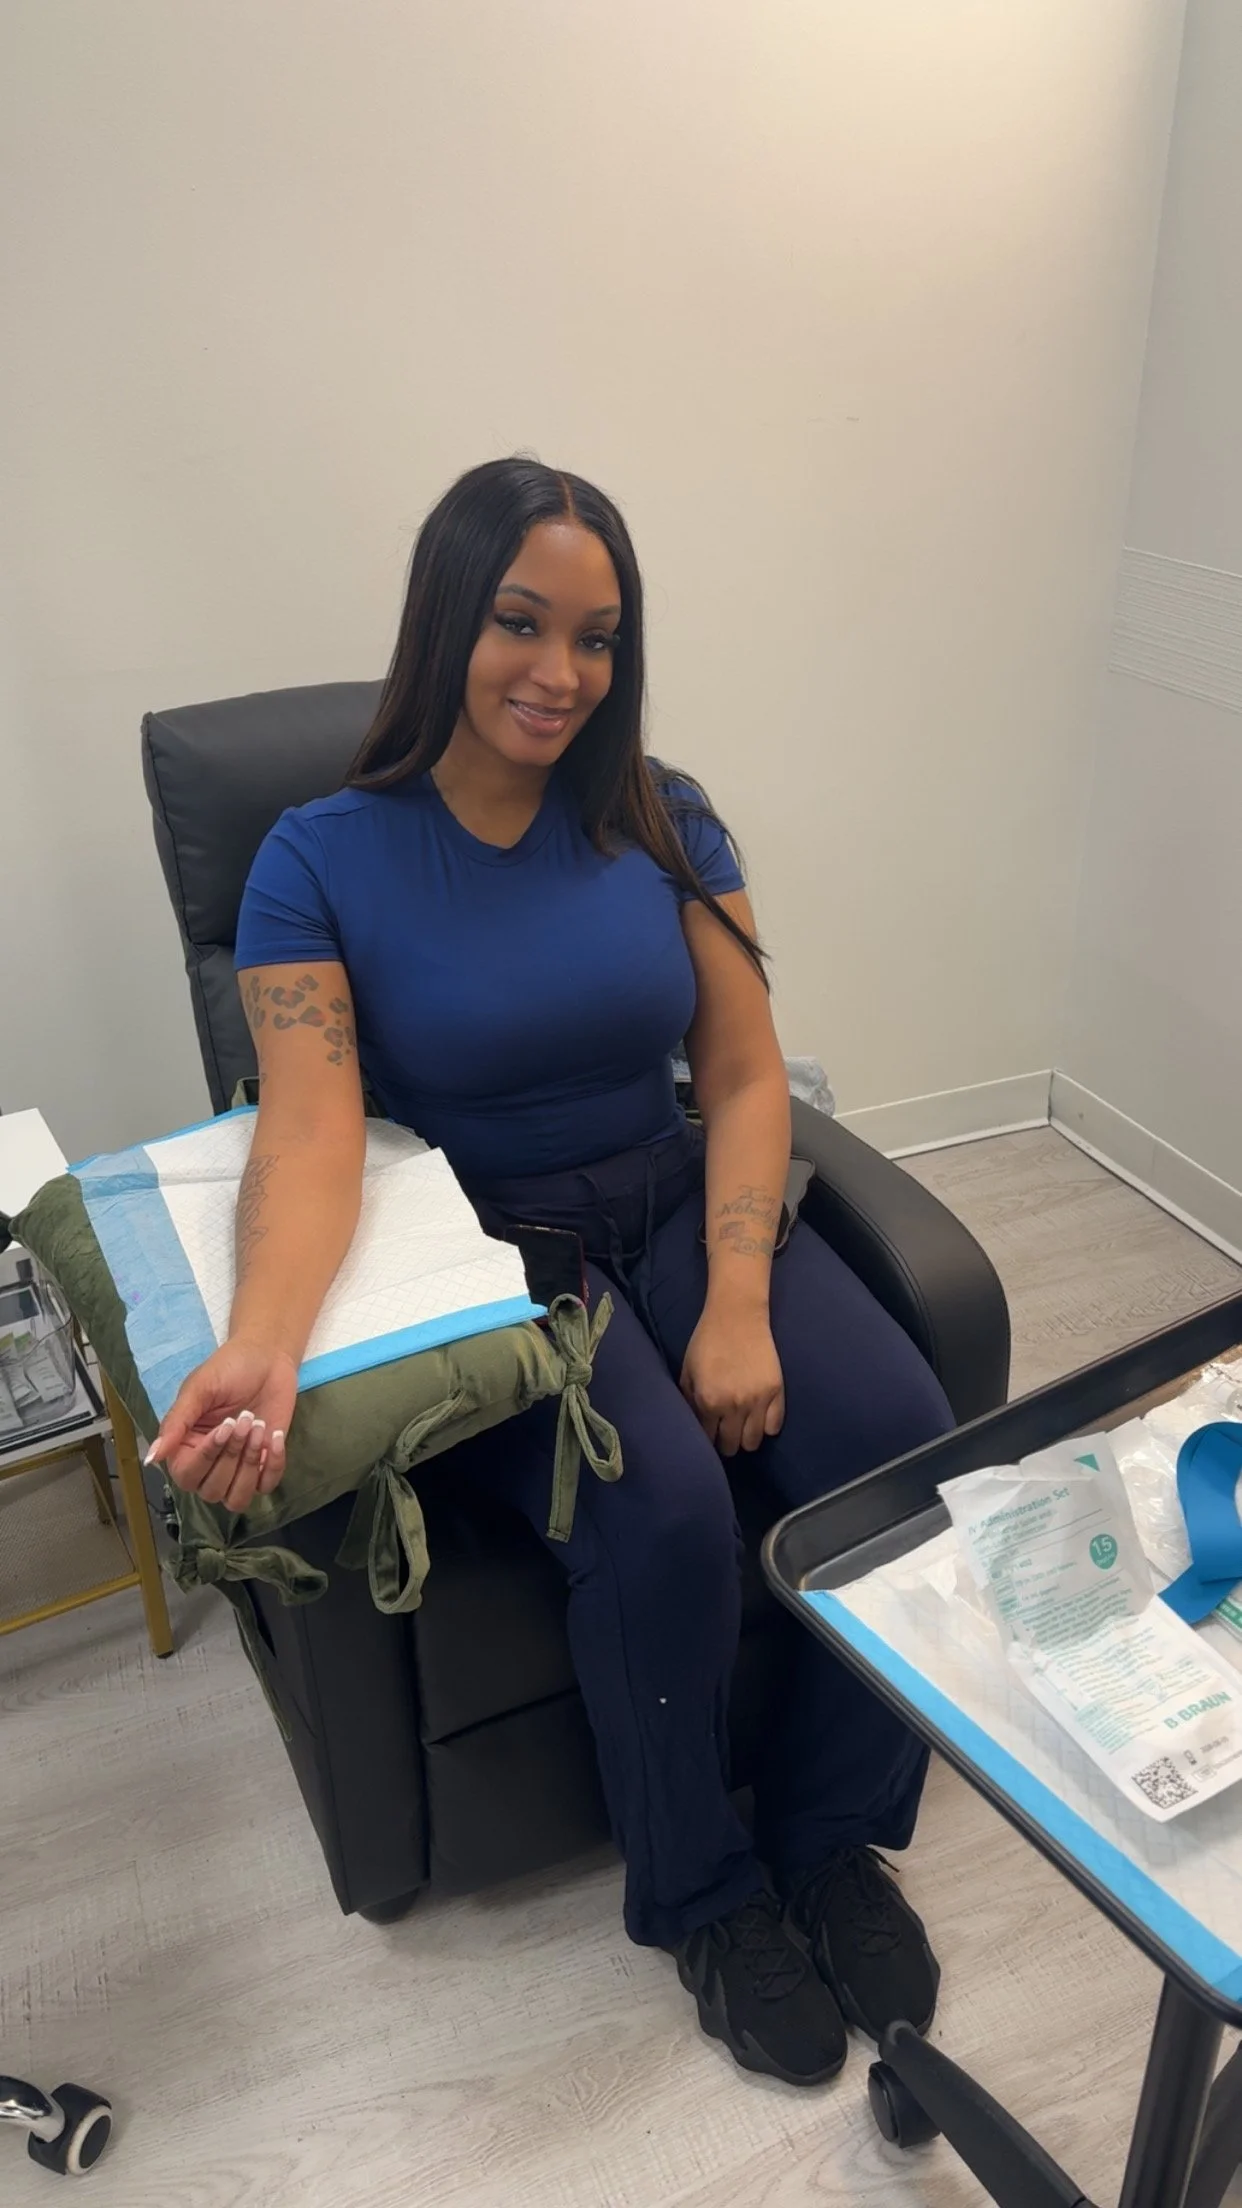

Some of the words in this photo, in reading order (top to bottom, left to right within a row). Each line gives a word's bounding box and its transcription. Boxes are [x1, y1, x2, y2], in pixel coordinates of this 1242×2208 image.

[980, 1496, 1052, 1527] Administration
[1052, 1487, 1070, 1500] Set
[1092, 1536, 1112, 1556] 15
[1177, 1691, 1232, 1721] BRAUN
